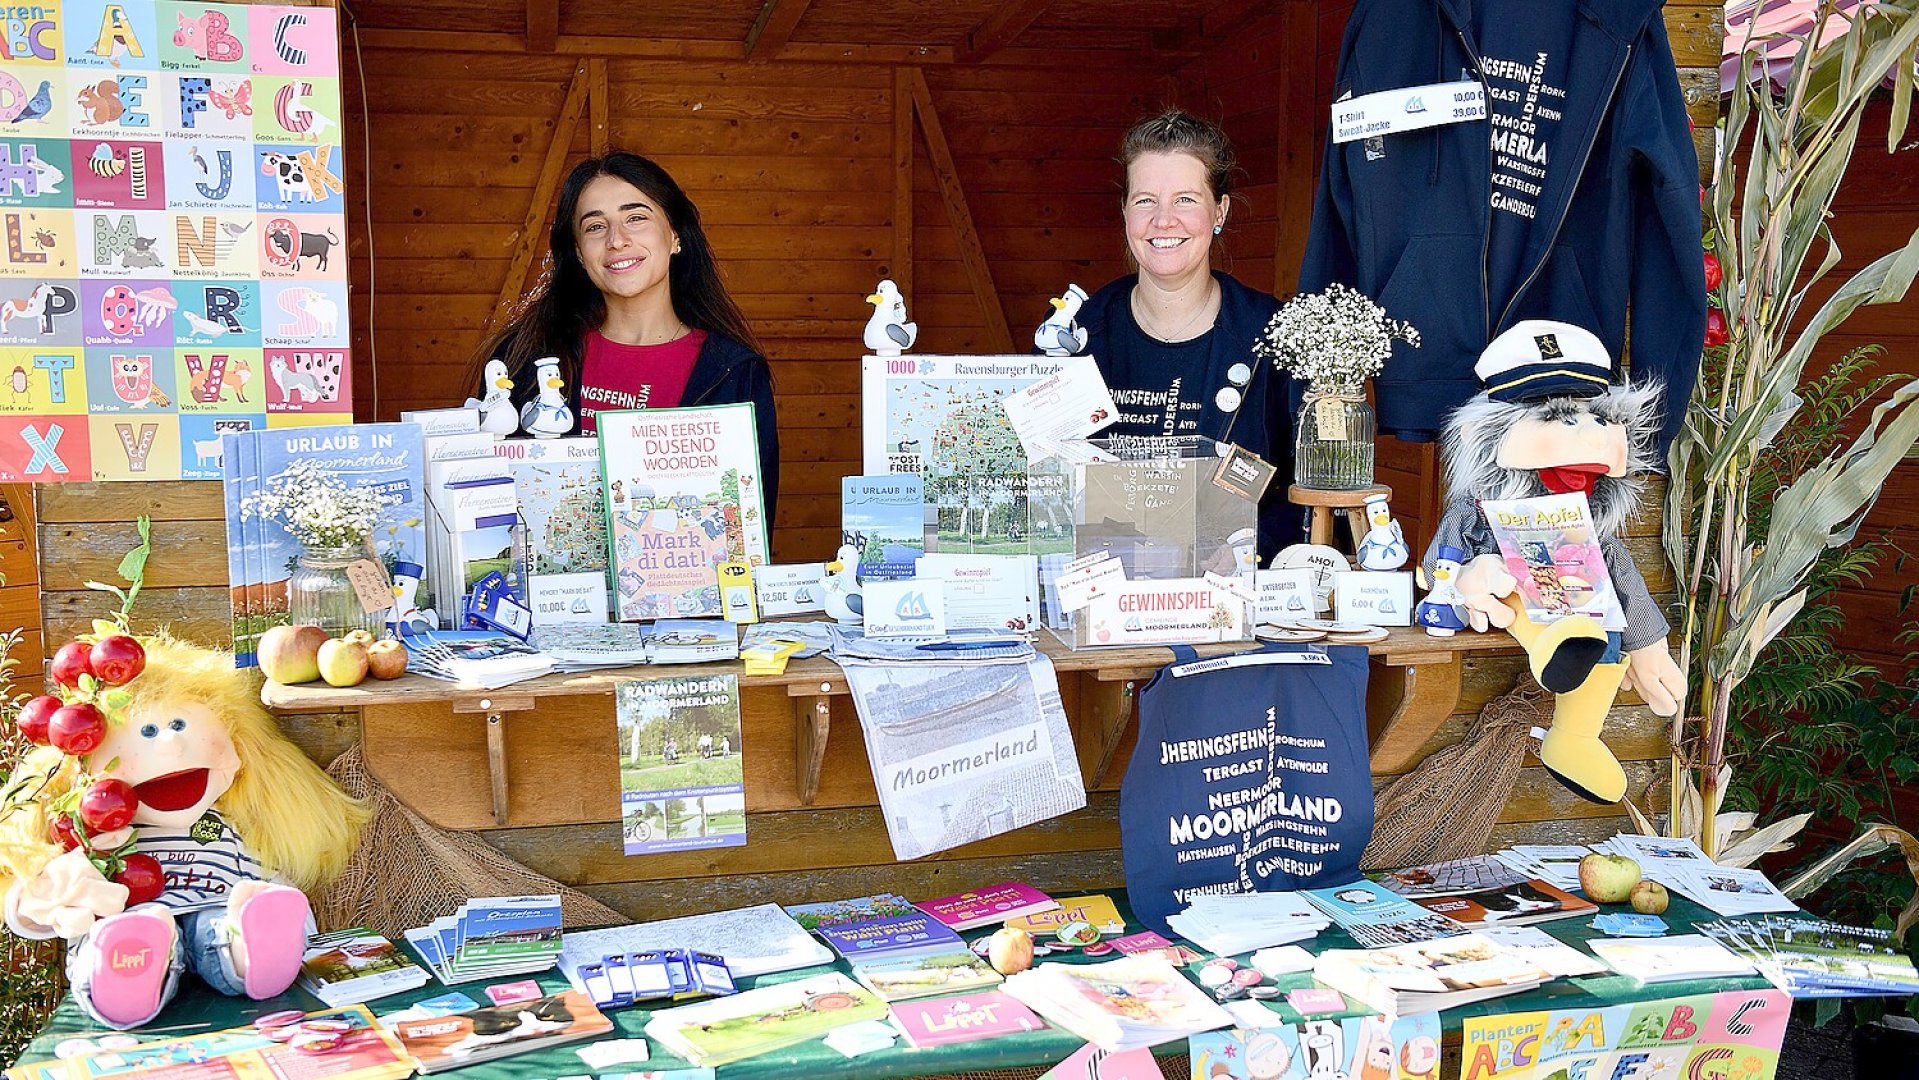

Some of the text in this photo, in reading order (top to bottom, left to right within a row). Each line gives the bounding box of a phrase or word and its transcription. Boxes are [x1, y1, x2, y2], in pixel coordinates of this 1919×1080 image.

[96, 4, 145, 58] A
[204, 9, 244, 62] B
[274, 13, 308, 65] C
[161, 61, 180, 70] Bigg
[117, 75, 149, 127] E
[179, 77, 211, 128] F
[274, 82, 313, 133] G
[1453, 91, 1475, 103] 10,00
[1476, 90, 1484, 101] €
[72, 128, 120, 139] Eekhoorntje
[1338, 105, 1485, 138] Sweat-Jacke 39,00 €
[195, 150, 232, 200] J
[297, 144, 344, 203] K
[5, 213, 47, 263] L
[93, 214, 140, 265] M
[176, 216, 216, 266] N
[45, 285, 78, 335] P
[101, 285, 144, 336] Q
[204, 284, 245, 335] R
[276, 287, 321, 337] S
[265, 337, 293, 346] Schaap
[33, 355, 75, 404] T
[109, 354, 153, 404] U
[184, 354, 229, 402] V
[293, 352, 344, 402] W
[886, 360, 916, 375] 1000
[954, 363, 1028, 377] Ravensburger
[286, 434, 394, 454] URLAUB IN
[631, 421, 721, 438] MIEN EERSTE
[645, 437, 716, 455] DUSEND
[19, 423, 70, 475] X
[493, 444, 526, 460] 1000
[643, 455, 719, 471] WOORDEN
[889, 464, 921, 473] FREES
[978, 475, 1063, 487] RADWANDERN
[863, 486, 917, 495] URLAUB IN
[1497, 506, 1584, 527] Der Apfel
[641, 531, 702, 550] Mark
[638, 551, 707, 570] di dat!
[1306, 554, 1335, 568] AHOI
[1118, 590, 1215, 612] GEWINNSPIEL
[1145, 622, 1208, 631] MOORMERLAND
[625, 680, 729, 700] RADWANDERN
[1160, 728, 1269, 765] JHERINGSFEHN
[1275, 735, 1326, 748] RORICHUM
[892, 729, 1038, 792] Moormerland
[1202, 758, 1264, 783] TERGAST
[1276, 756, 1329, 774] AYENWOLDE
[1208, 777, 1282, 810] NEERMOOR
[1169, 791, 1343, 845] MOORMERLAND
[1255, 820, 1328, 838] WARSINGSFEHN
[1177, 843, 1237, 864] HATSHAUSEN
[1255, 855, 1323, 878] GANDERSUM
[1471, 1022, 1543, 1044] Planten-
[1562, 1013, 1605, 1051] A
[1661, 1005, 1697, 1041] B
[1726, 998, 1768, 1036] C
[1466, 1034, 1539, 1080] ABC
